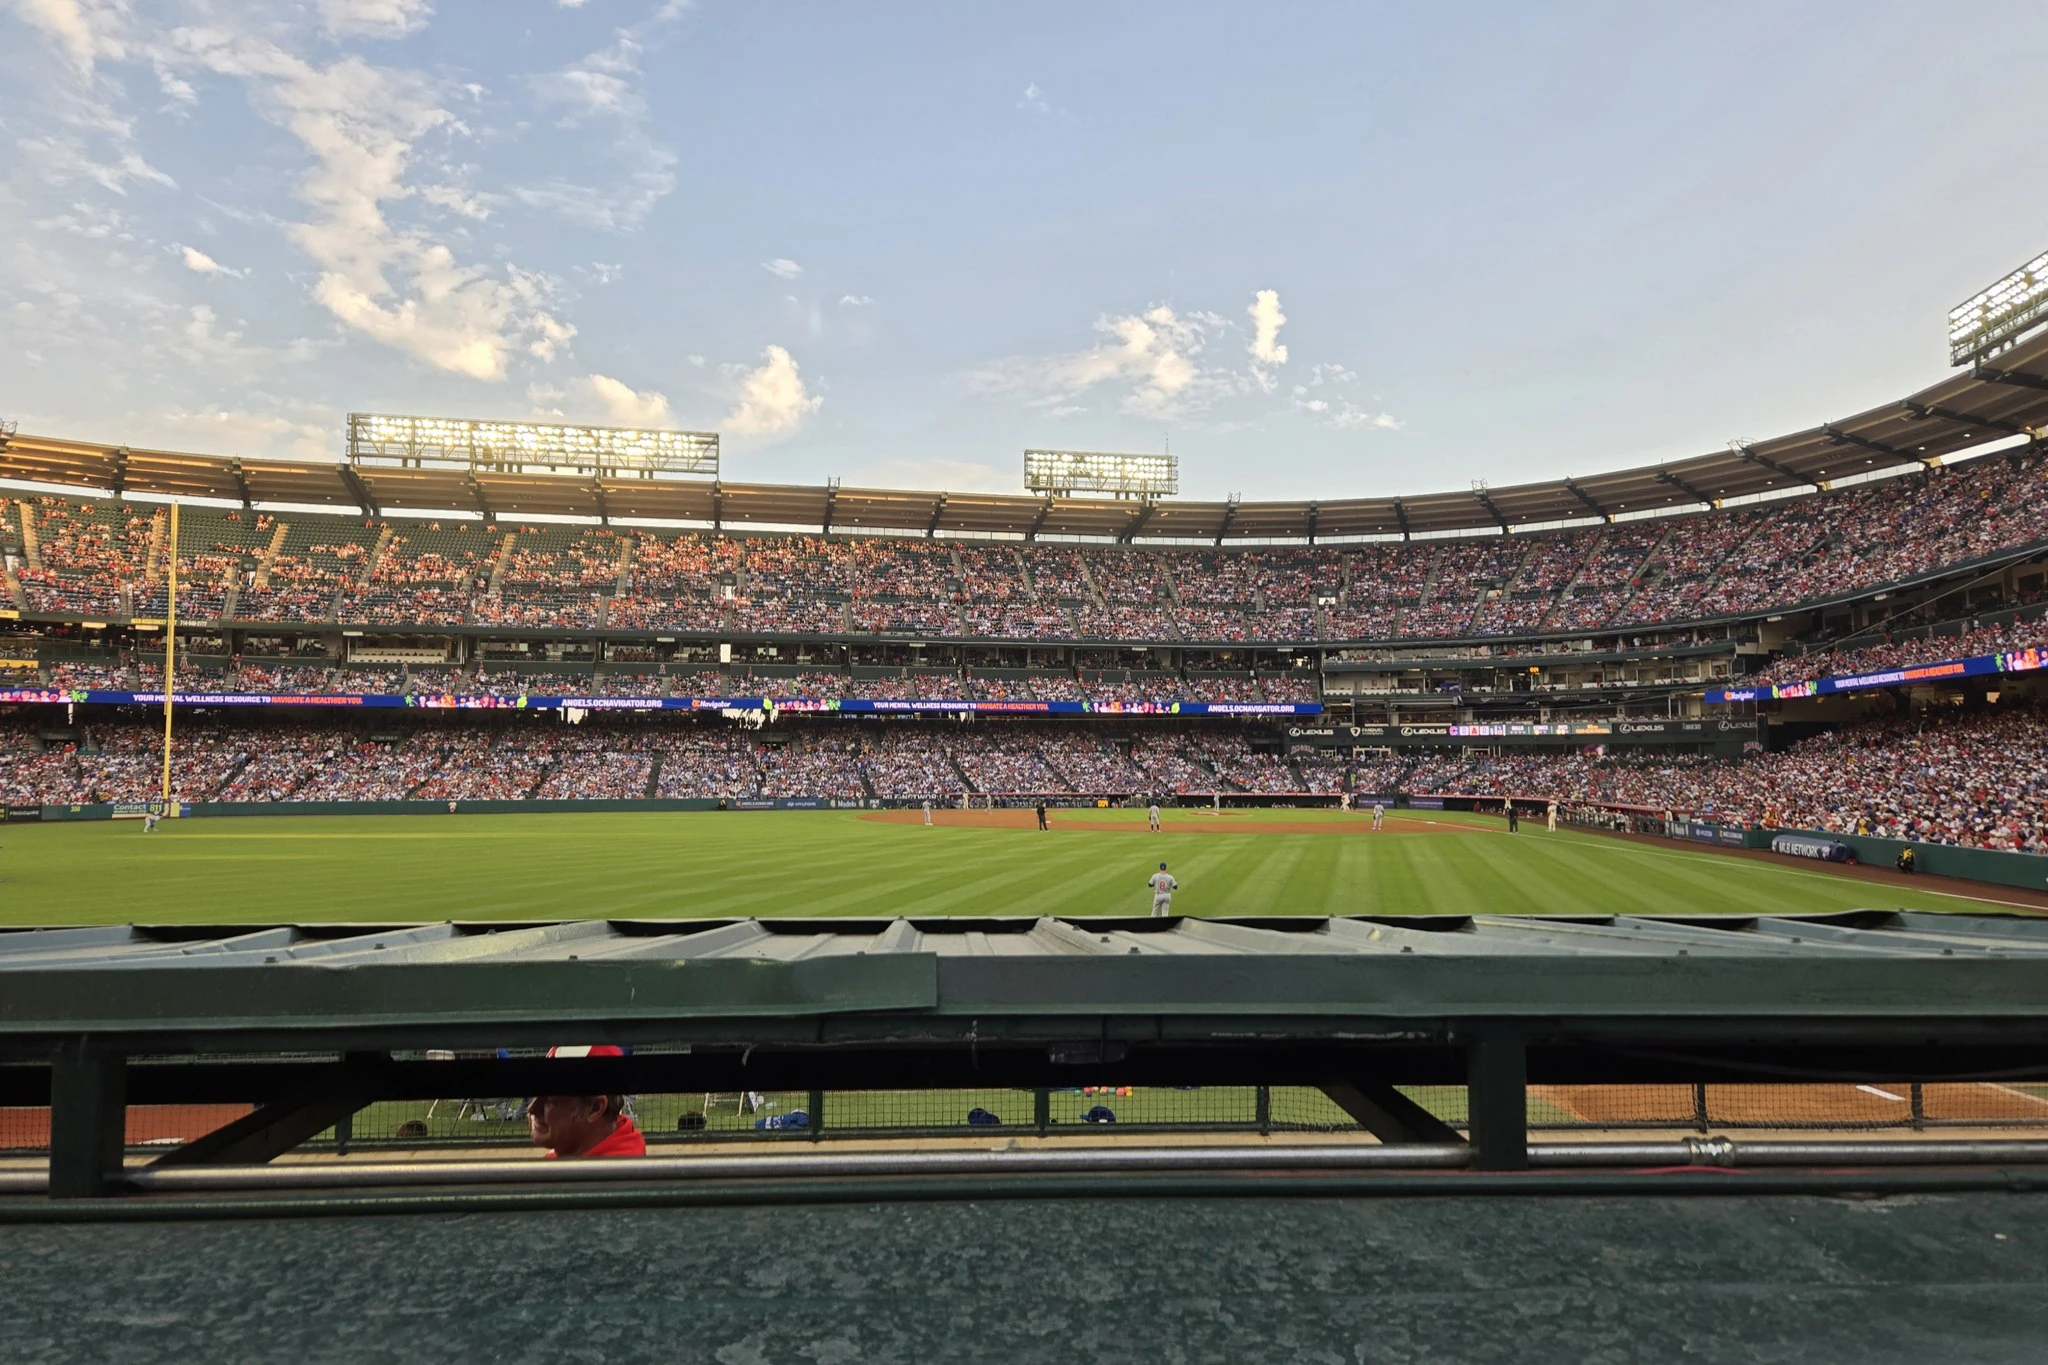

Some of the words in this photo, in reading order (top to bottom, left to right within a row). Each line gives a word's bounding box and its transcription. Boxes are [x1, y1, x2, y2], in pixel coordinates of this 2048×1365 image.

[133, 694, 154, 702] YOUR
[154, 694, 185, 702] METAL
[185, 695, 224, 703] WELLNESS
[224, 695, 262, 703] RESOURCE
[262, 695, 271, 703] TO
[271, 696, 305, 704] NAVIGATE
[561, 698, 663, 708] ANGELS.OCNAVIGATOR.ORG
[873, 701, 889, 709] YOUR
[889, 701, 911, 709] MENTAL
[1208, 704, 1295, 713] ANGELS.OCNAVIGATOR.ORG
[149, 803, 162, 812] 811
[1779, 841, 1791, 854] MLB
[1790, 843, 1820, 858] NETWORK
